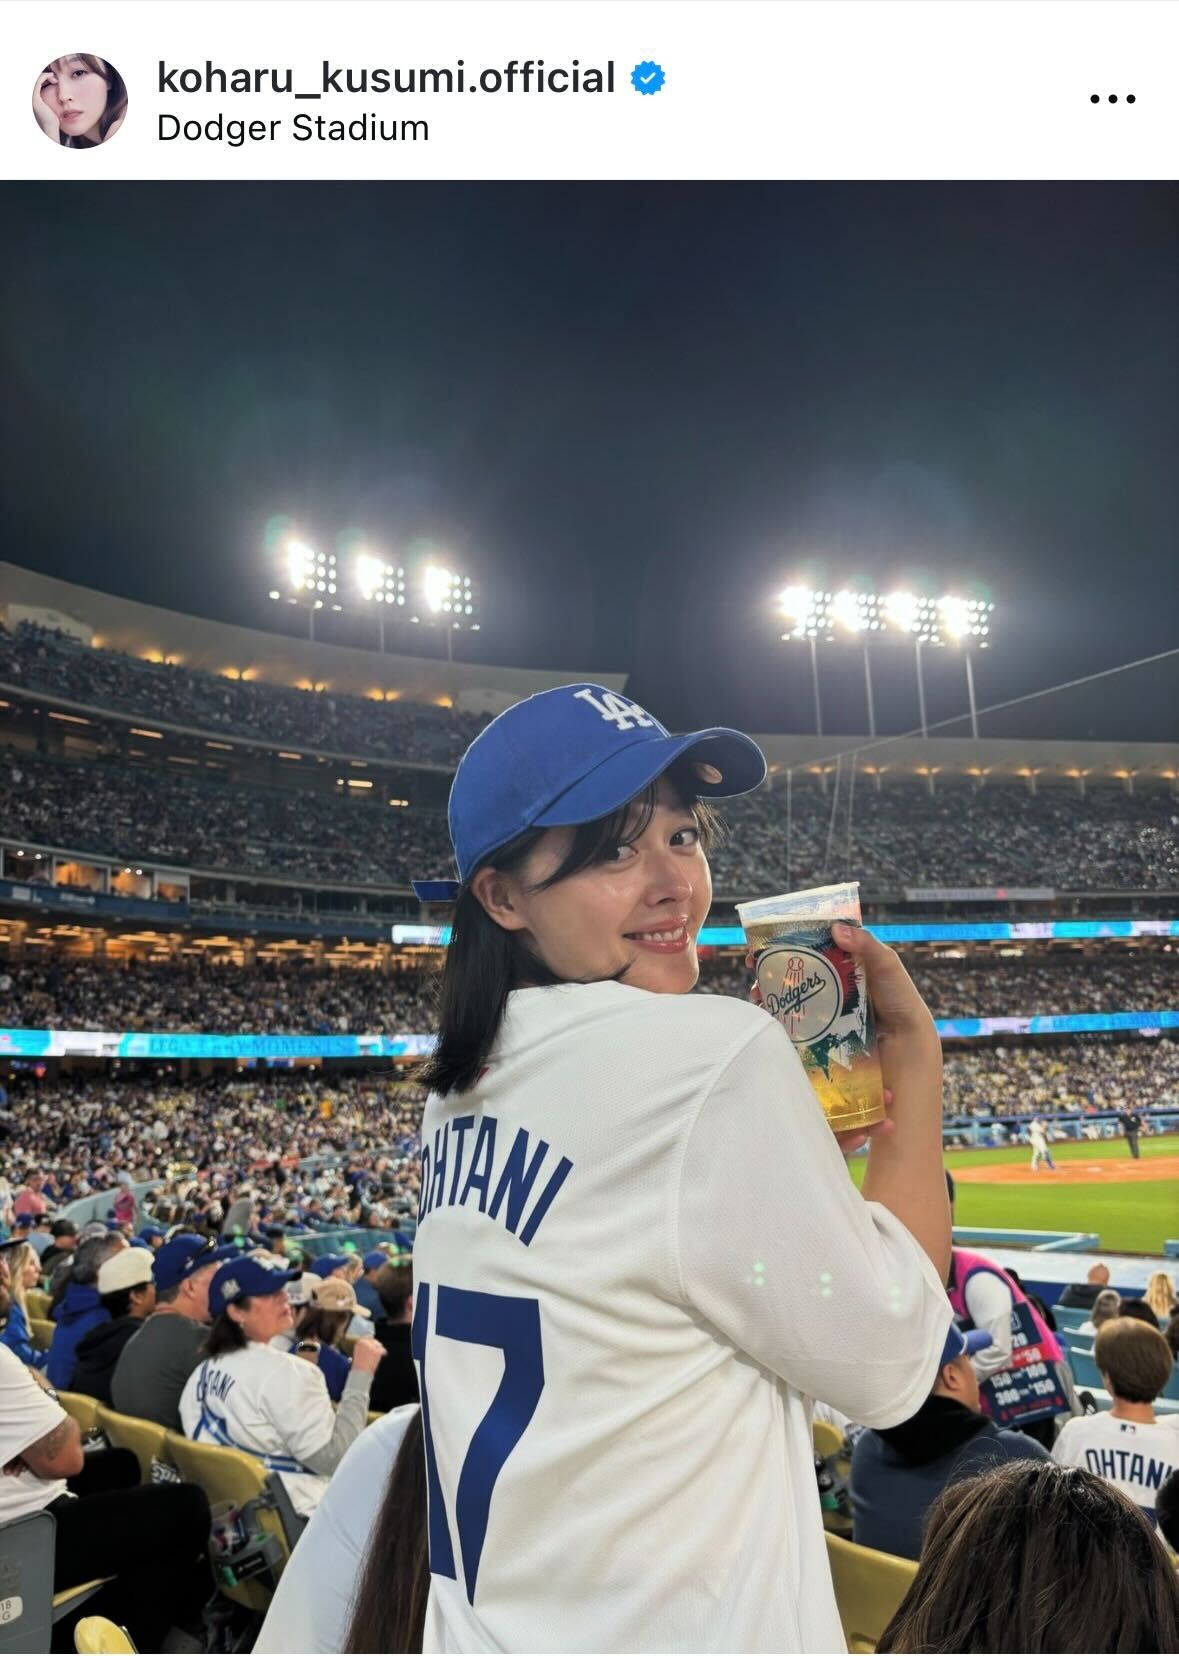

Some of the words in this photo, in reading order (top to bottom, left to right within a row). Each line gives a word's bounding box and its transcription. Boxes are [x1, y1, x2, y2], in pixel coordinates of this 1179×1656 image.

[573, 688, 654, 730] LA
[766, 971, 826, 1016] Dodgers
[417, 1115, 574, 1247] OHTANI
[411, 1281, 545, 1608] 17
